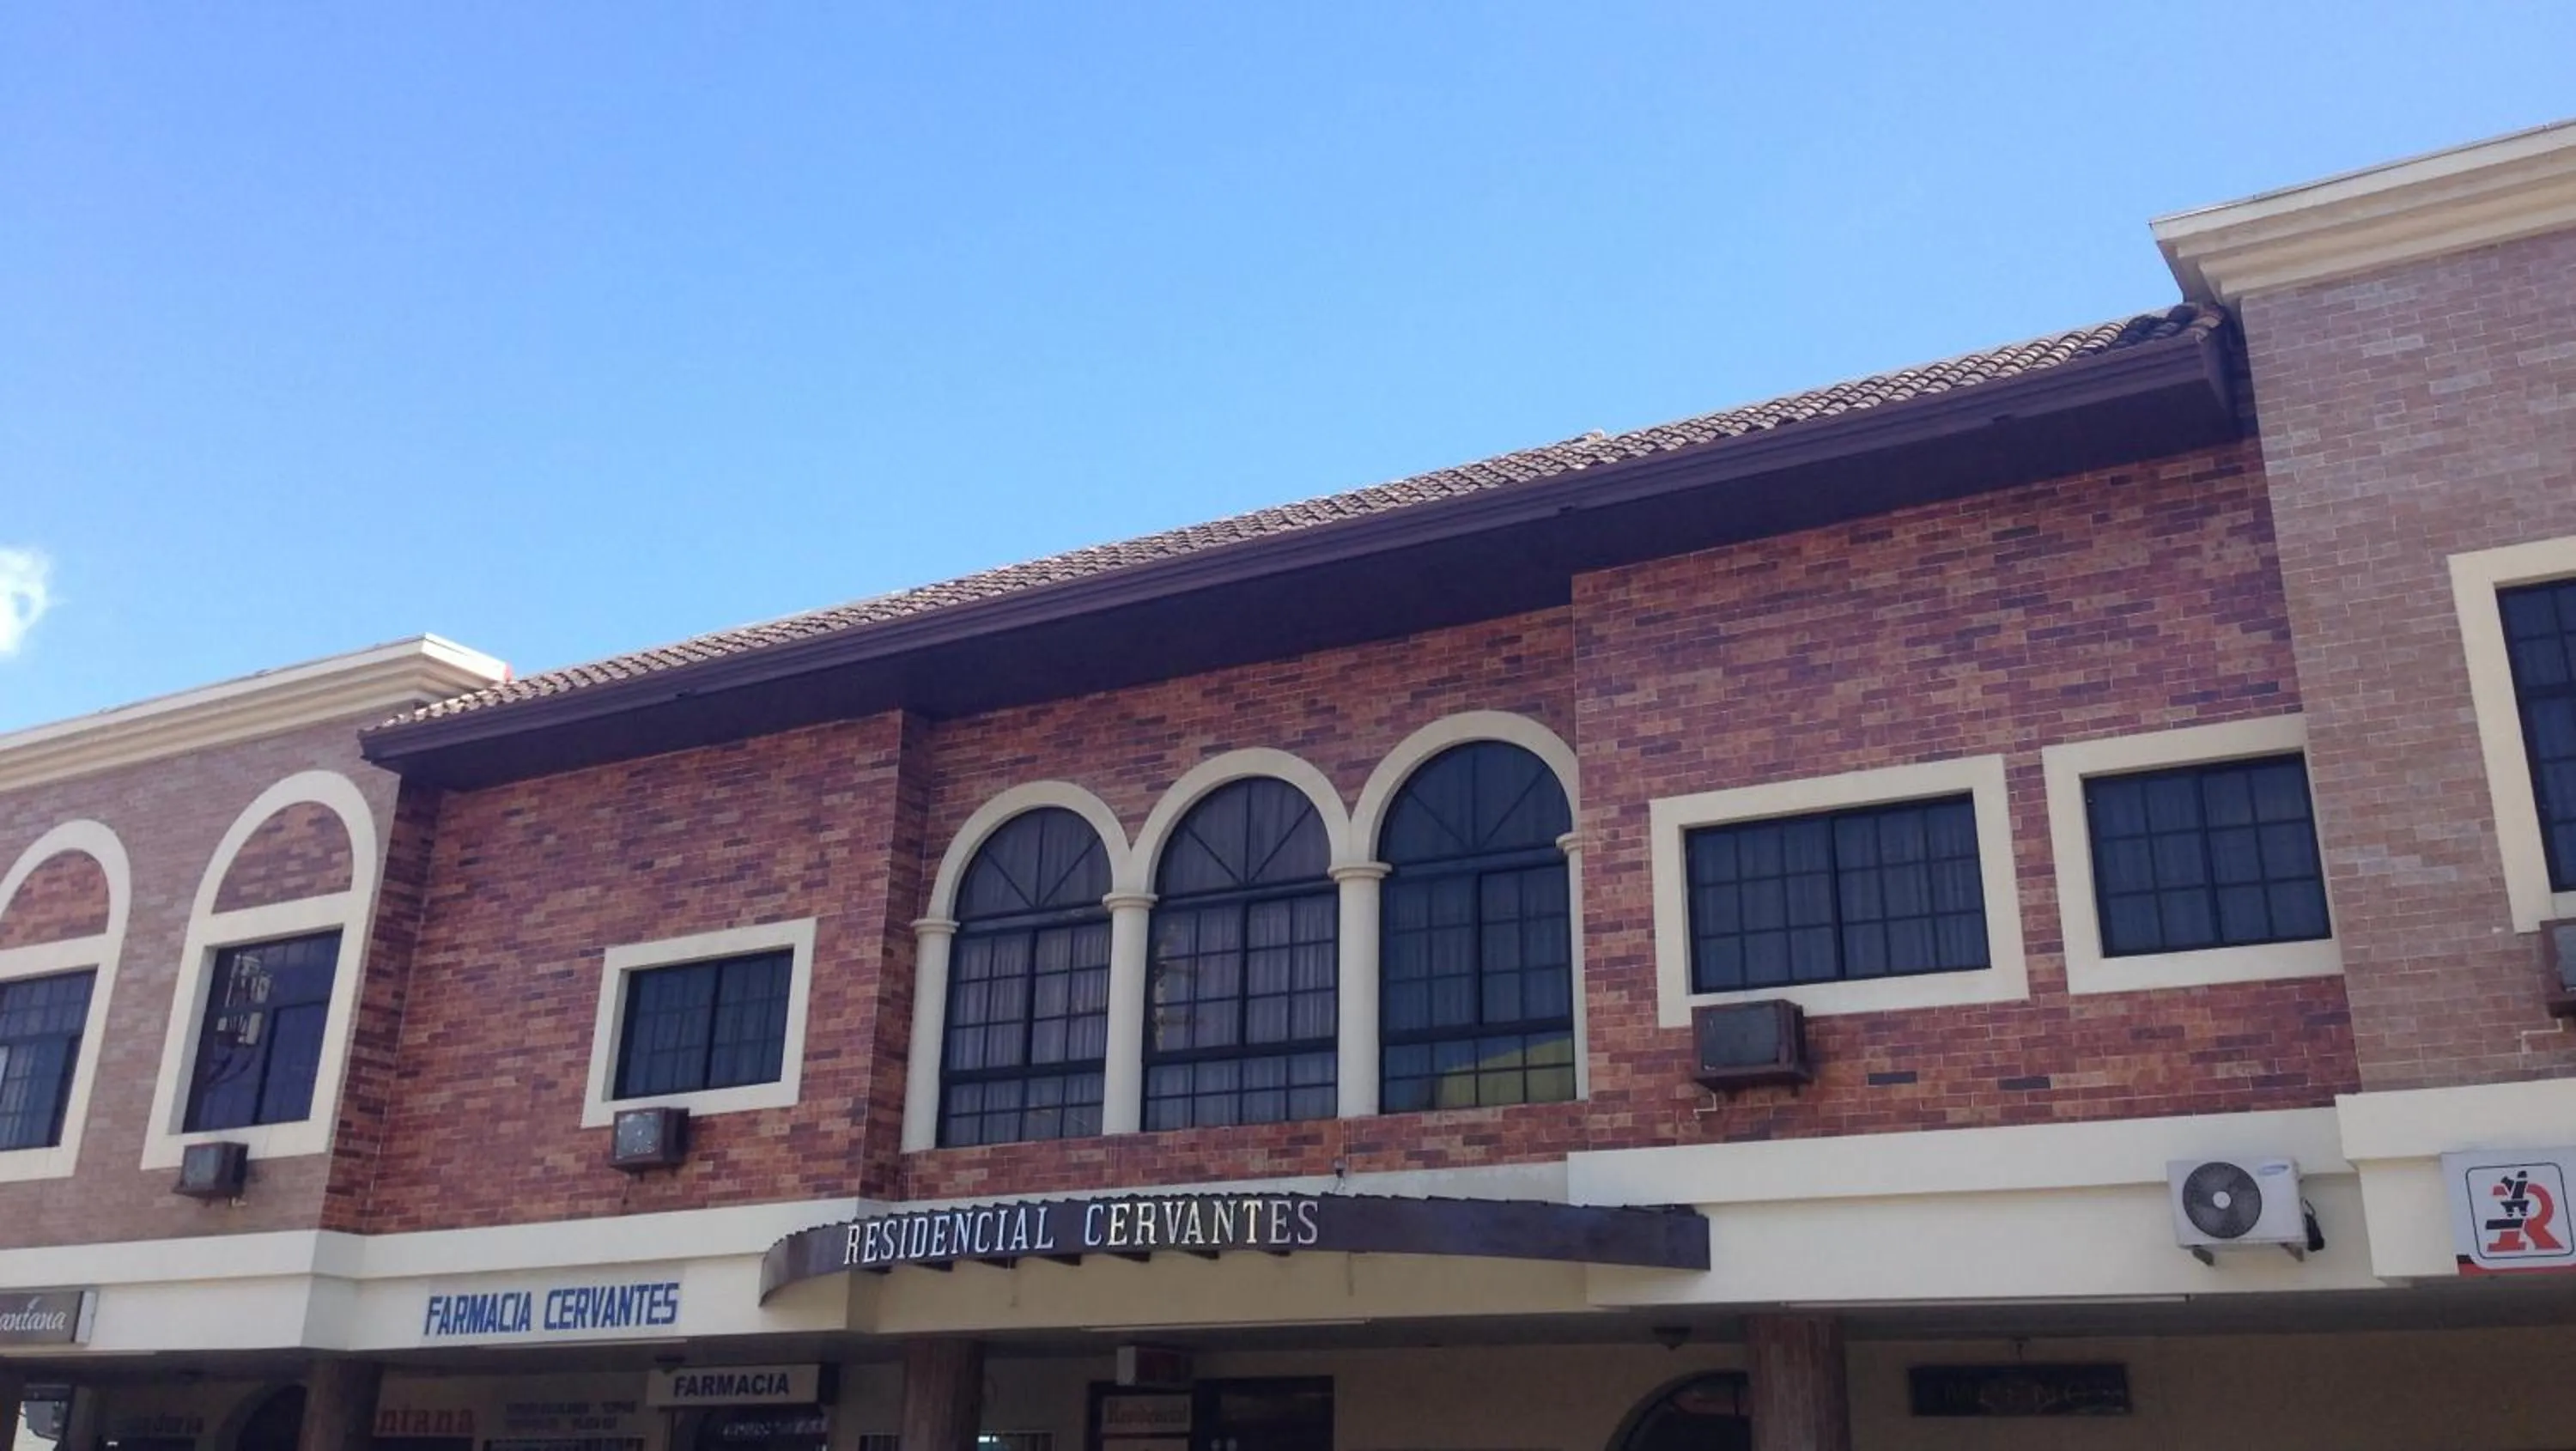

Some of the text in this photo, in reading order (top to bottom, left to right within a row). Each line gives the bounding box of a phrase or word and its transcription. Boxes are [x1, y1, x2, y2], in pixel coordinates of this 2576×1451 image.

[842, 1199, 1321, 1266] RESIDENCIAL CERVANTES
[423, 1282, 679, 1337] FARMACIA CERVANTES
[673, 1371, 790, 1398] FARMACIA
